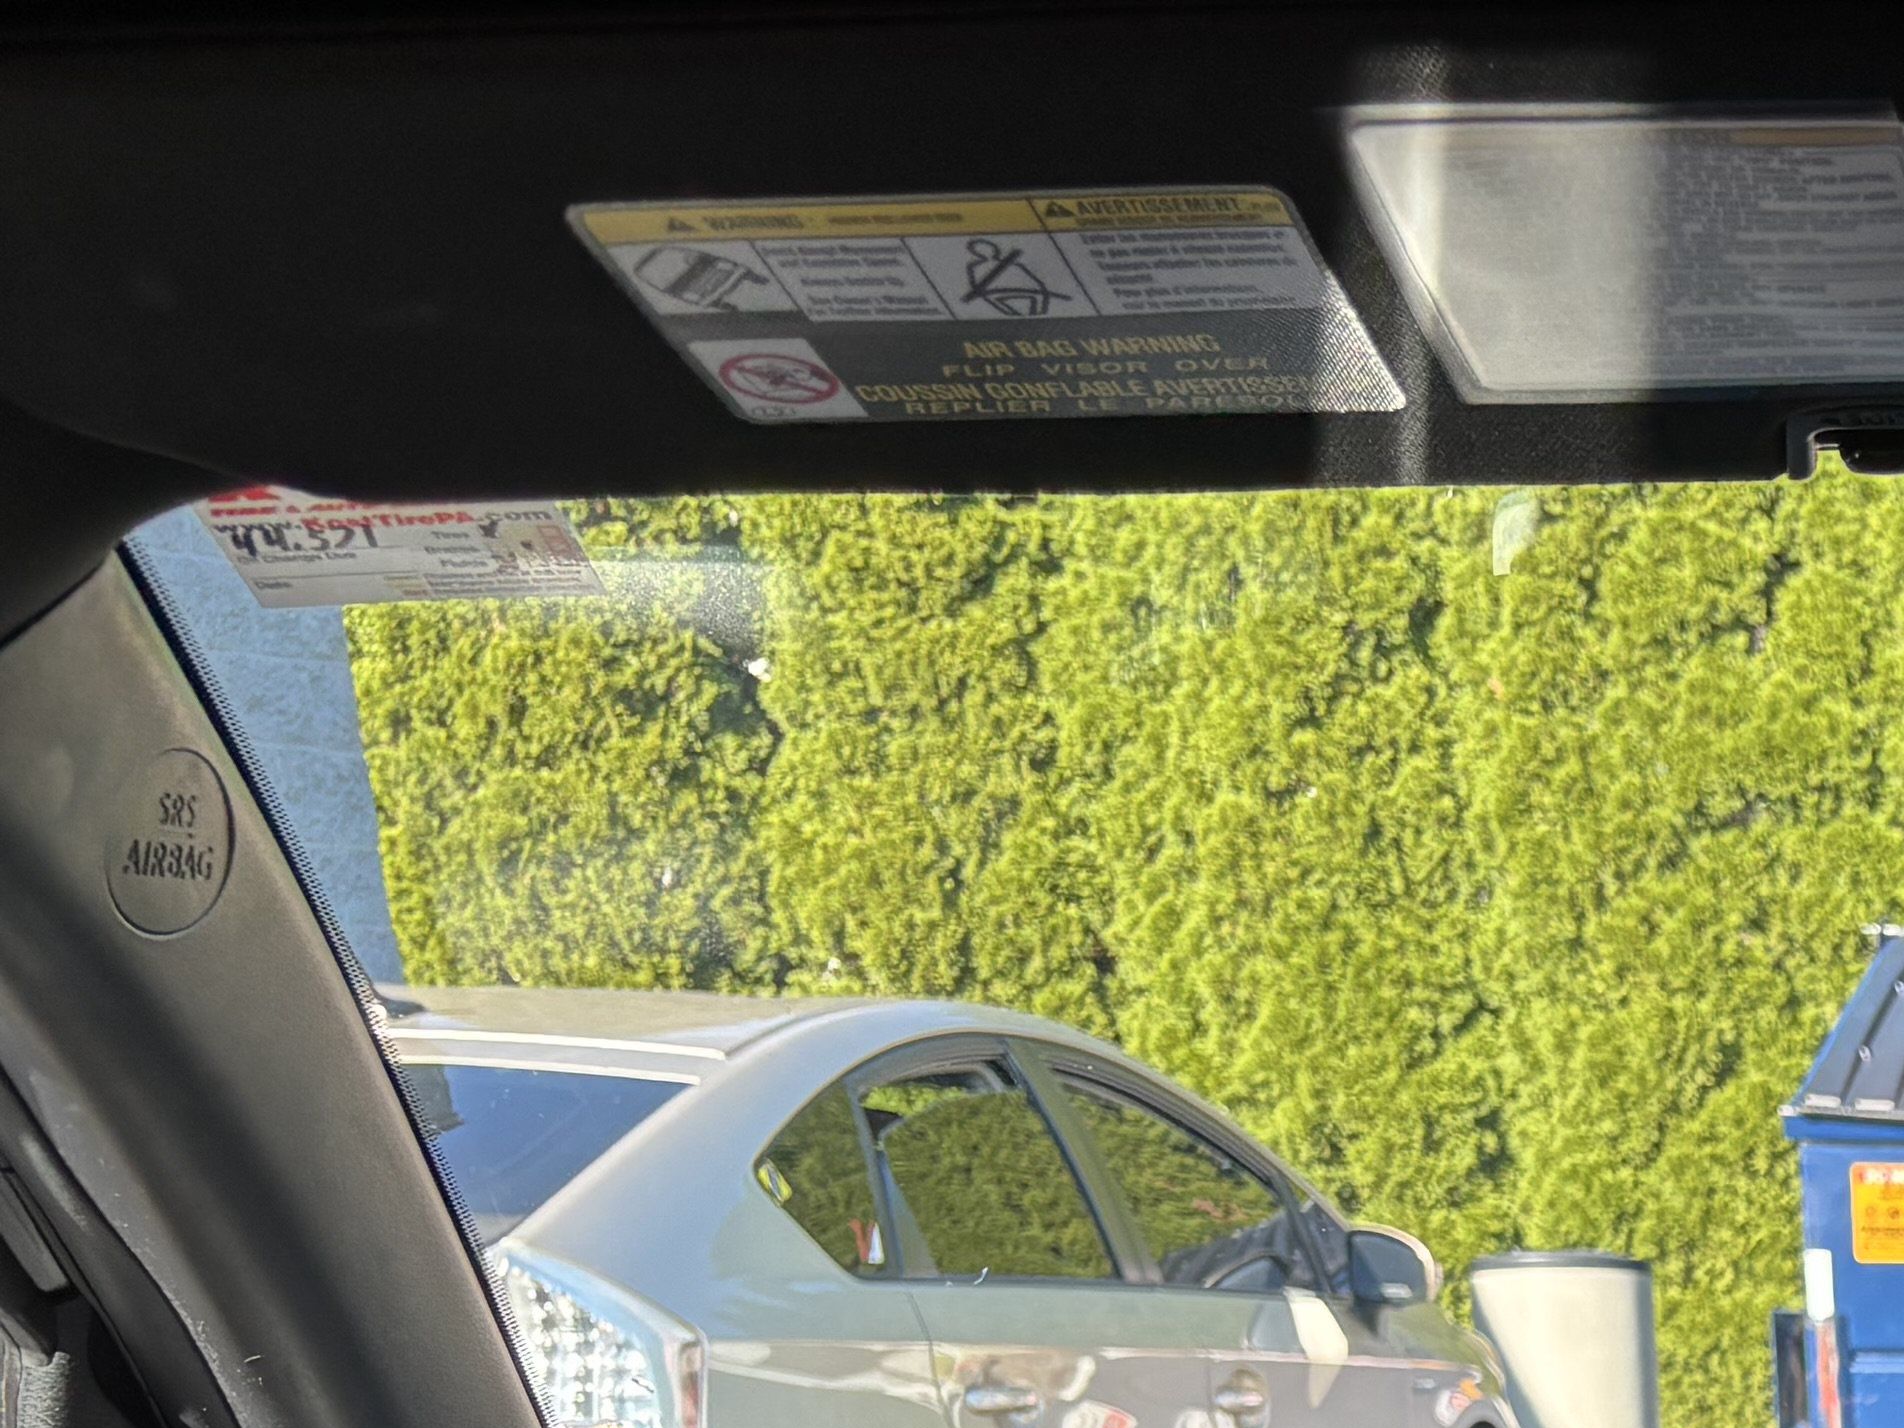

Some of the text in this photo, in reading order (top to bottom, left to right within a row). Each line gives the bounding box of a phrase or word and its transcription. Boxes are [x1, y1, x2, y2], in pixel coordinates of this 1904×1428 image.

[962, 333, 1222, 359] AIR BAG WARNING
[941, 355, 1269, 377] FLIP VISOR OVER
[853, 382, 983, 402] COUSSIN
[905, 398, 1119, 415] REPLIER LE
[158, 793, 198, 827] SRS
[122, 838, 215, 883] AIRBAG
